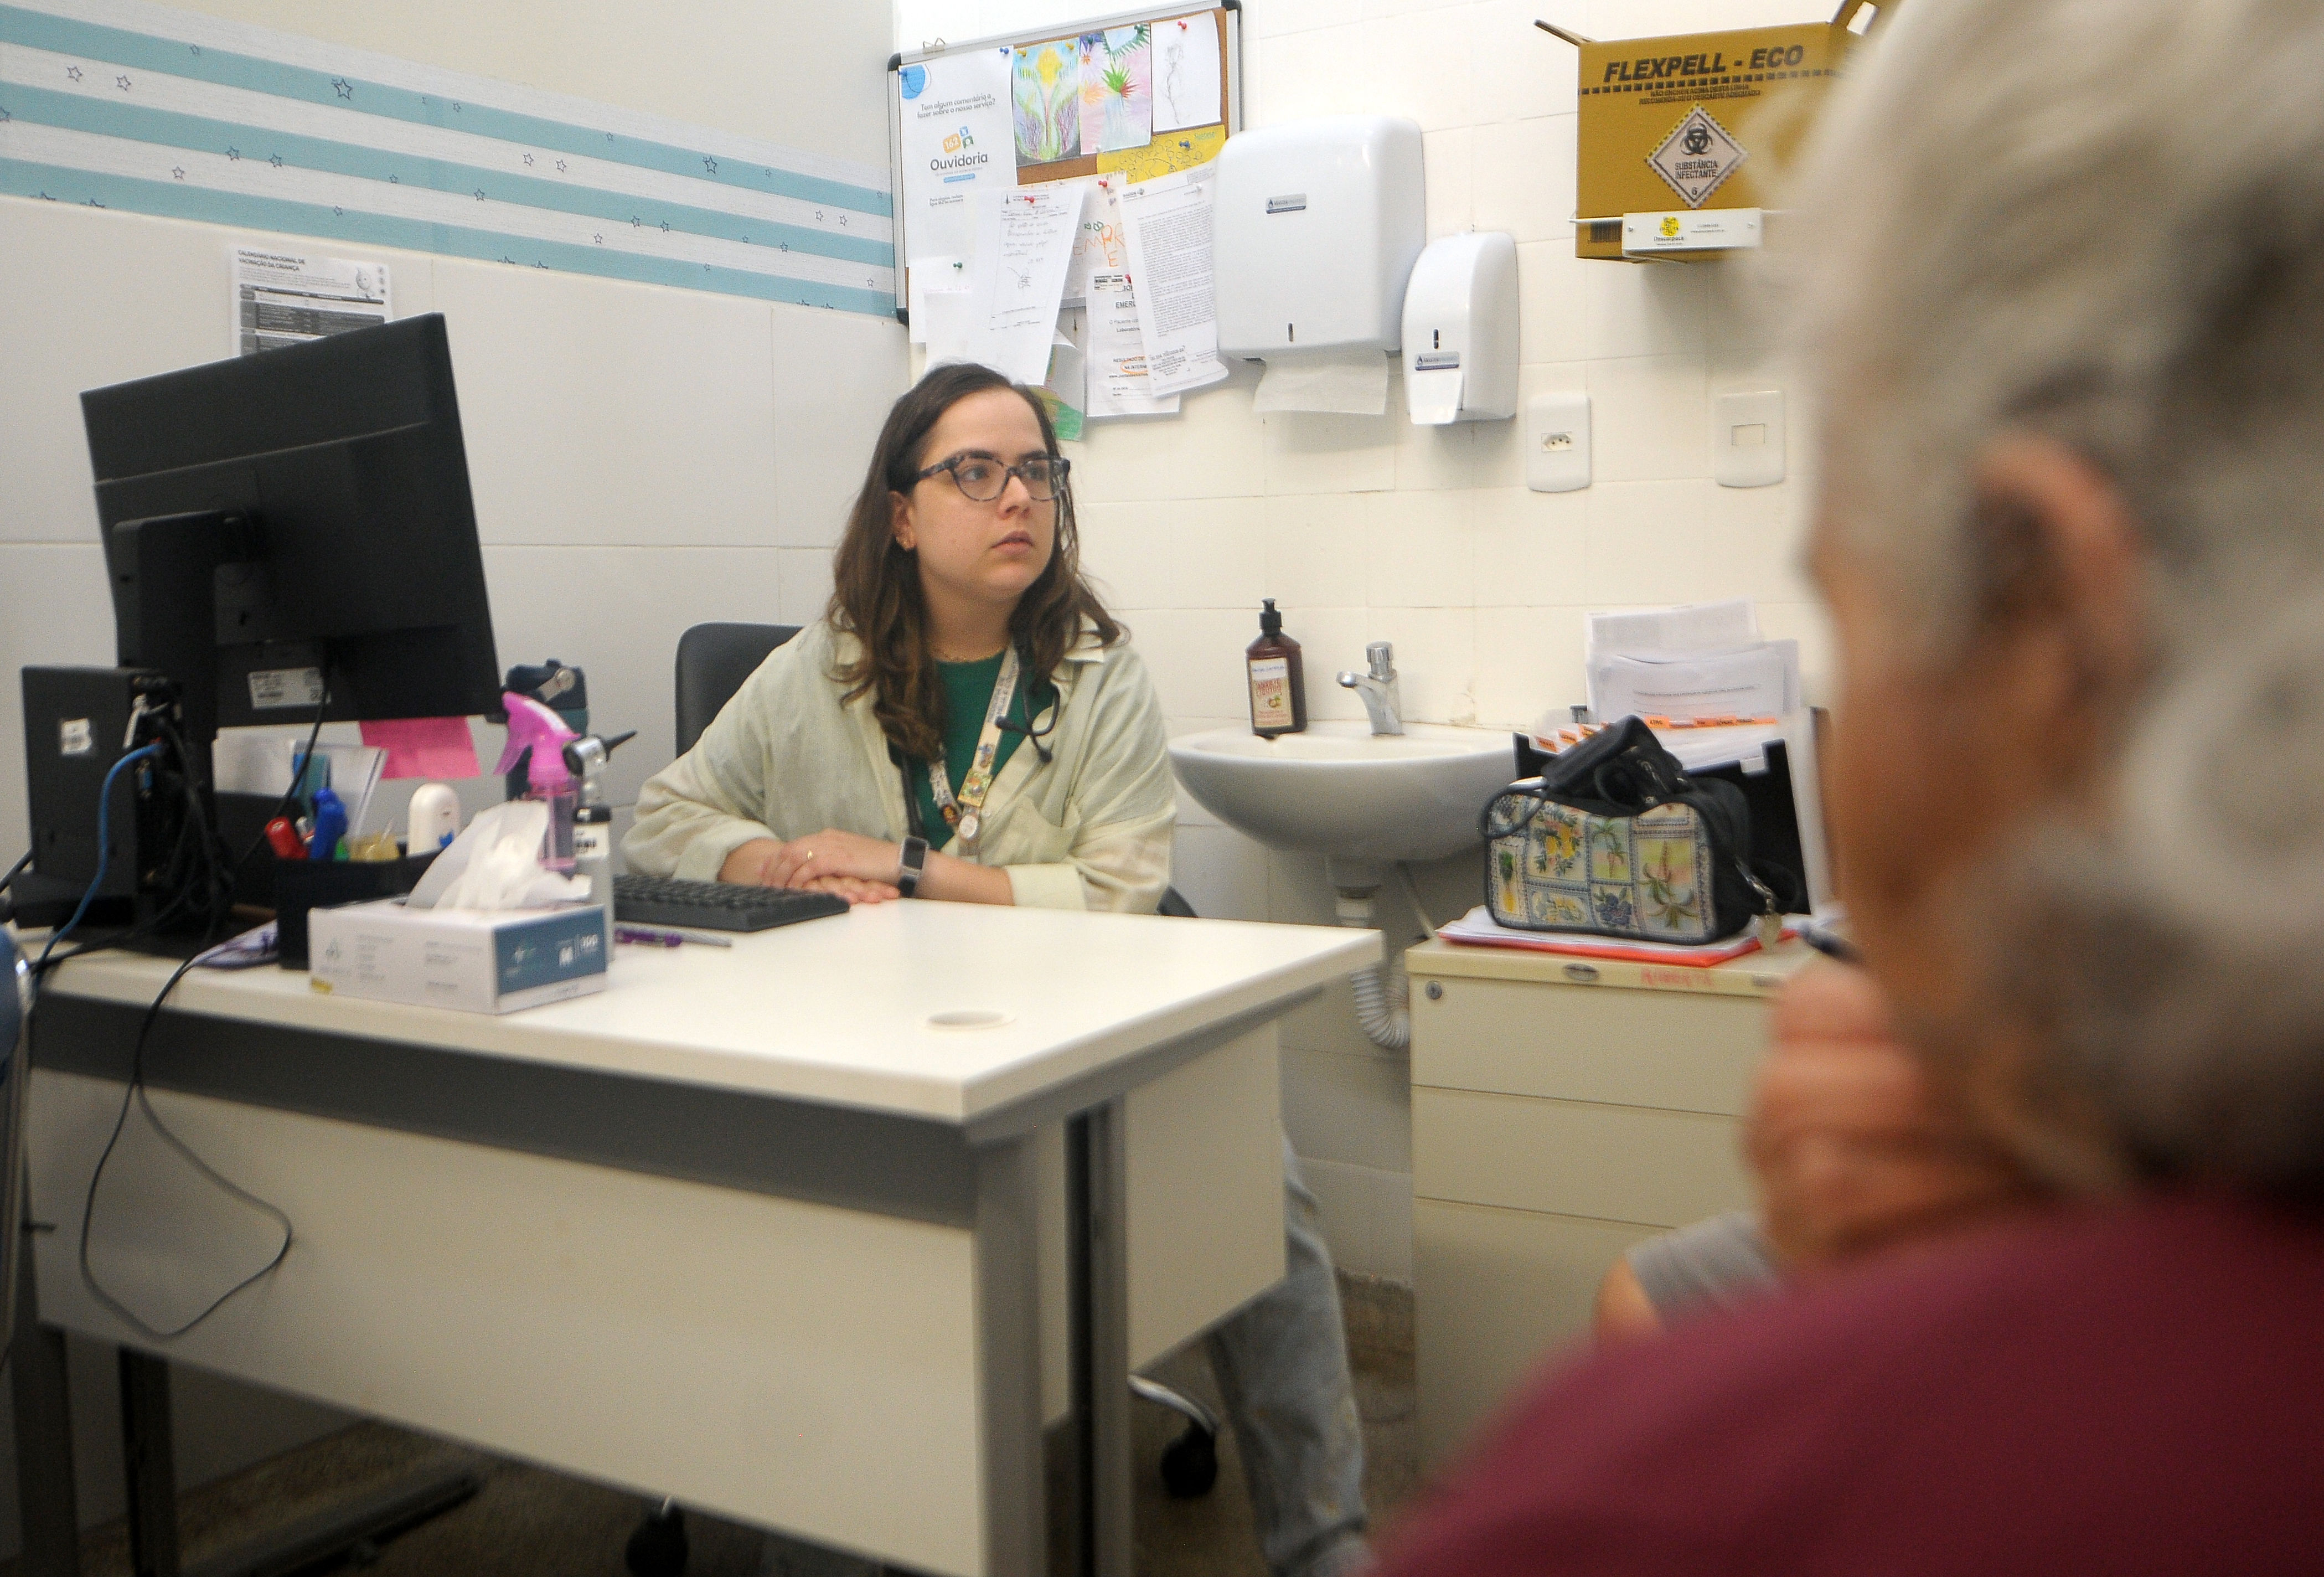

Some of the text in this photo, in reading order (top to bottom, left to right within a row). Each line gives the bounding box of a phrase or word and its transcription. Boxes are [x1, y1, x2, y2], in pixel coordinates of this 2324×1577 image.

[1603, 53, 1726, 82] FLEXPELL
[1749, 45, 1804, 69] ECO
[932, 107, 949, 116] sobre
[974, 98, 995, 109] serviço?
[934, 101, 953, 109] algum
[954, 93, 986, 105] comentário
[946, 137, 959, 149] 162
[930, 152, 988, 171] Ouvidoria
[1675, 159, 1717, 170] SUBSTÂNCIA
[1675, 169, 1716, 179] INFECTANTE
[1691, 187, 1697, 195] 6
